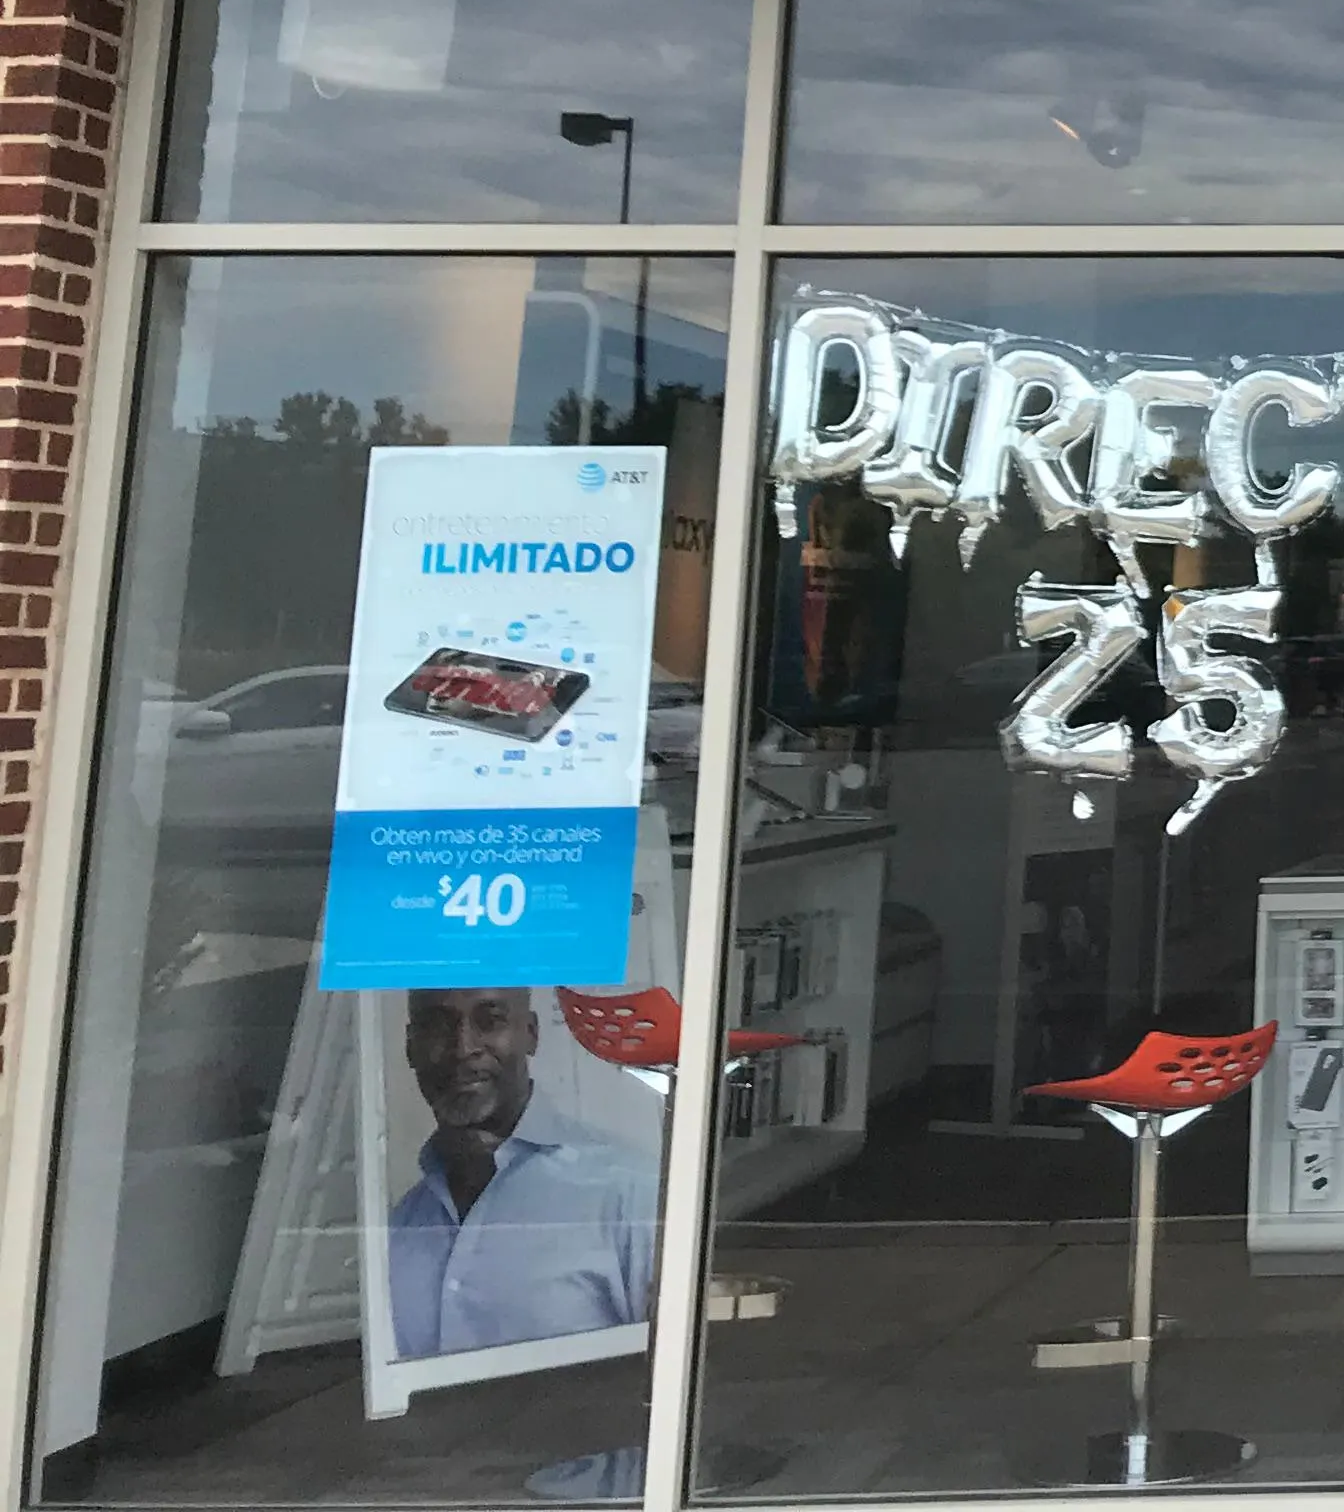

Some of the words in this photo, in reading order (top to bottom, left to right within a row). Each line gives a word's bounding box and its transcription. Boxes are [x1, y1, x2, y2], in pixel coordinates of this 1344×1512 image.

[610, 470, 649, 485] AT&T
[422, 542, 635, 574] ILIMITADO
[479, 825, 504, 844] de
[507, 825, 528, 844] 35
[531, 825, 602, 844] canales
[387, 851, 411, 866] en
[415, 848, 453, 865] vivo
[456, 850, 469, 869] y
[471, 845, 583, 865] on-demand
[438, 873, 526, 927] $40
